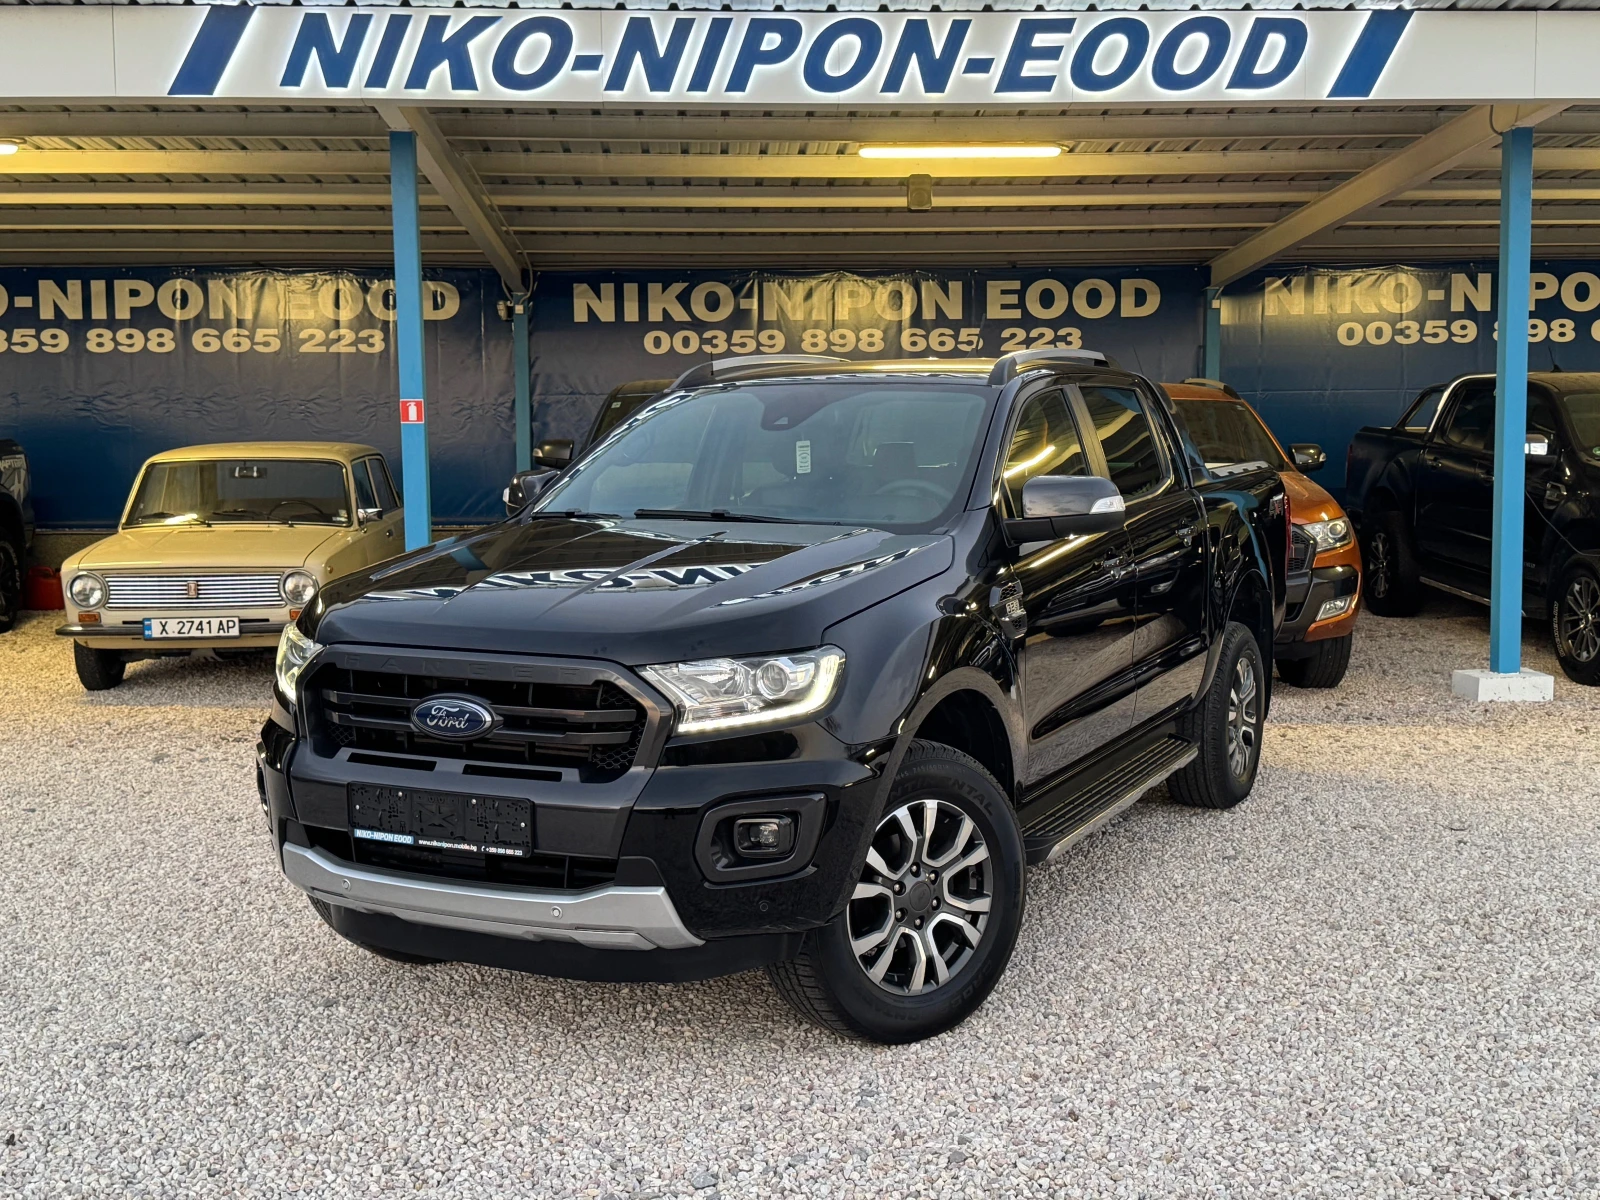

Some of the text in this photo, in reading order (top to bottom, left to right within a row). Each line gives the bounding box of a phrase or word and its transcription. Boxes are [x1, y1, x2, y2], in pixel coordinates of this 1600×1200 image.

[280, 13, 1308, 93] NIKO-NIPON-EOOD
[0, 278, 460, 321] -NIPON EOOD
[573, 278, 1161, 323] NIKO-NIPON EOOD
[1264, 272, 1600, 316] NIKO-NPO
[86, 328, 176, 354] 898
[192, 327, 282, 354] 665
[298, 328, 386, 354] 223
[643, 326, 1083, 355] 00359 898 665 223
[1336, 319, 1478, 347] 00359
[1492, 318, 1576, 343] 98
[176, 619, 213, 635] 2741
[217, 619, 236, 634] AP
[426, 705, 470, 729] Ford
[355, 829, 412, 845] NIKO-NIPON EOOD
